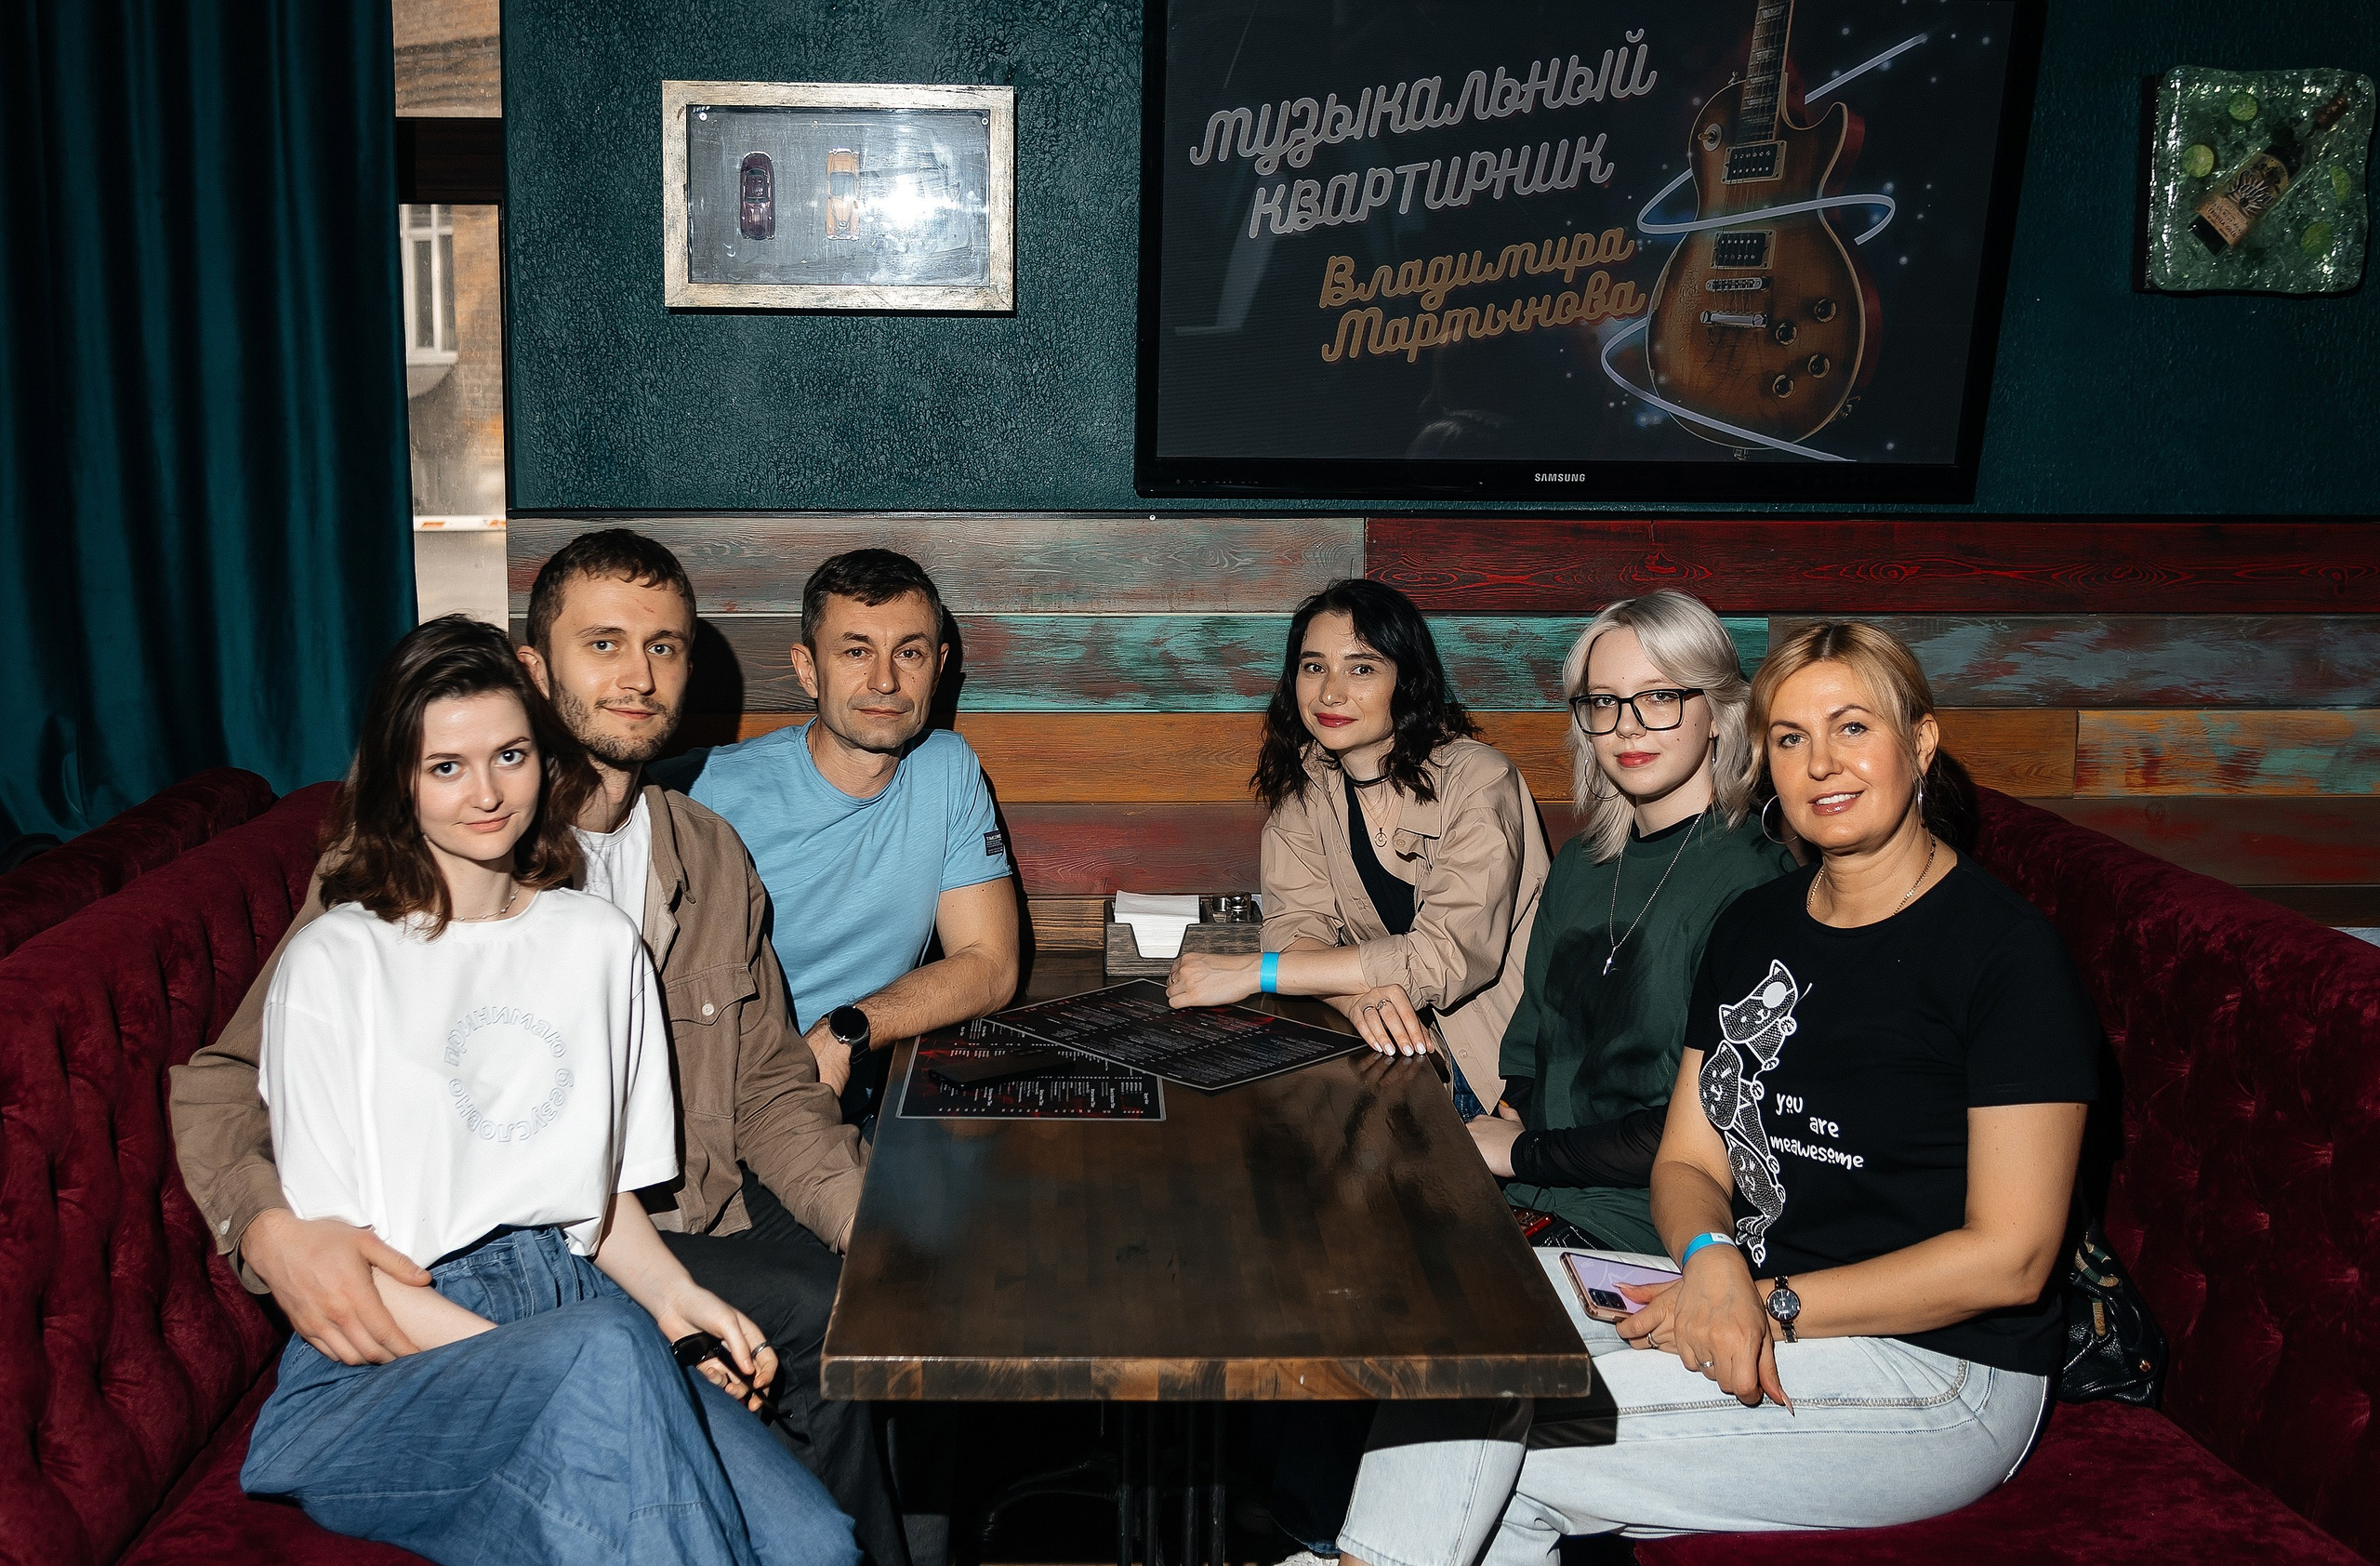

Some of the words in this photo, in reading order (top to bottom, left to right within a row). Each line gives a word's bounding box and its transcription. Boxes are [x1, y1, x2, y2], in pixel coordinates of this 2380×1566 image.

[1319, 227, 1635, 311] Владимира
[1321, 270, 1646, 364] Мартынова
[1534, 472, 1586, 483] SAMSUNG
[443, 1005, 567, 1068] принимаю
[448, 1068, 575, 1143] безусловно
[1775, 1093, 1804, 1116] you
[1809, 1116, 1839, 1138] are
[1769, 1135, 1864, 1171] meawesome
